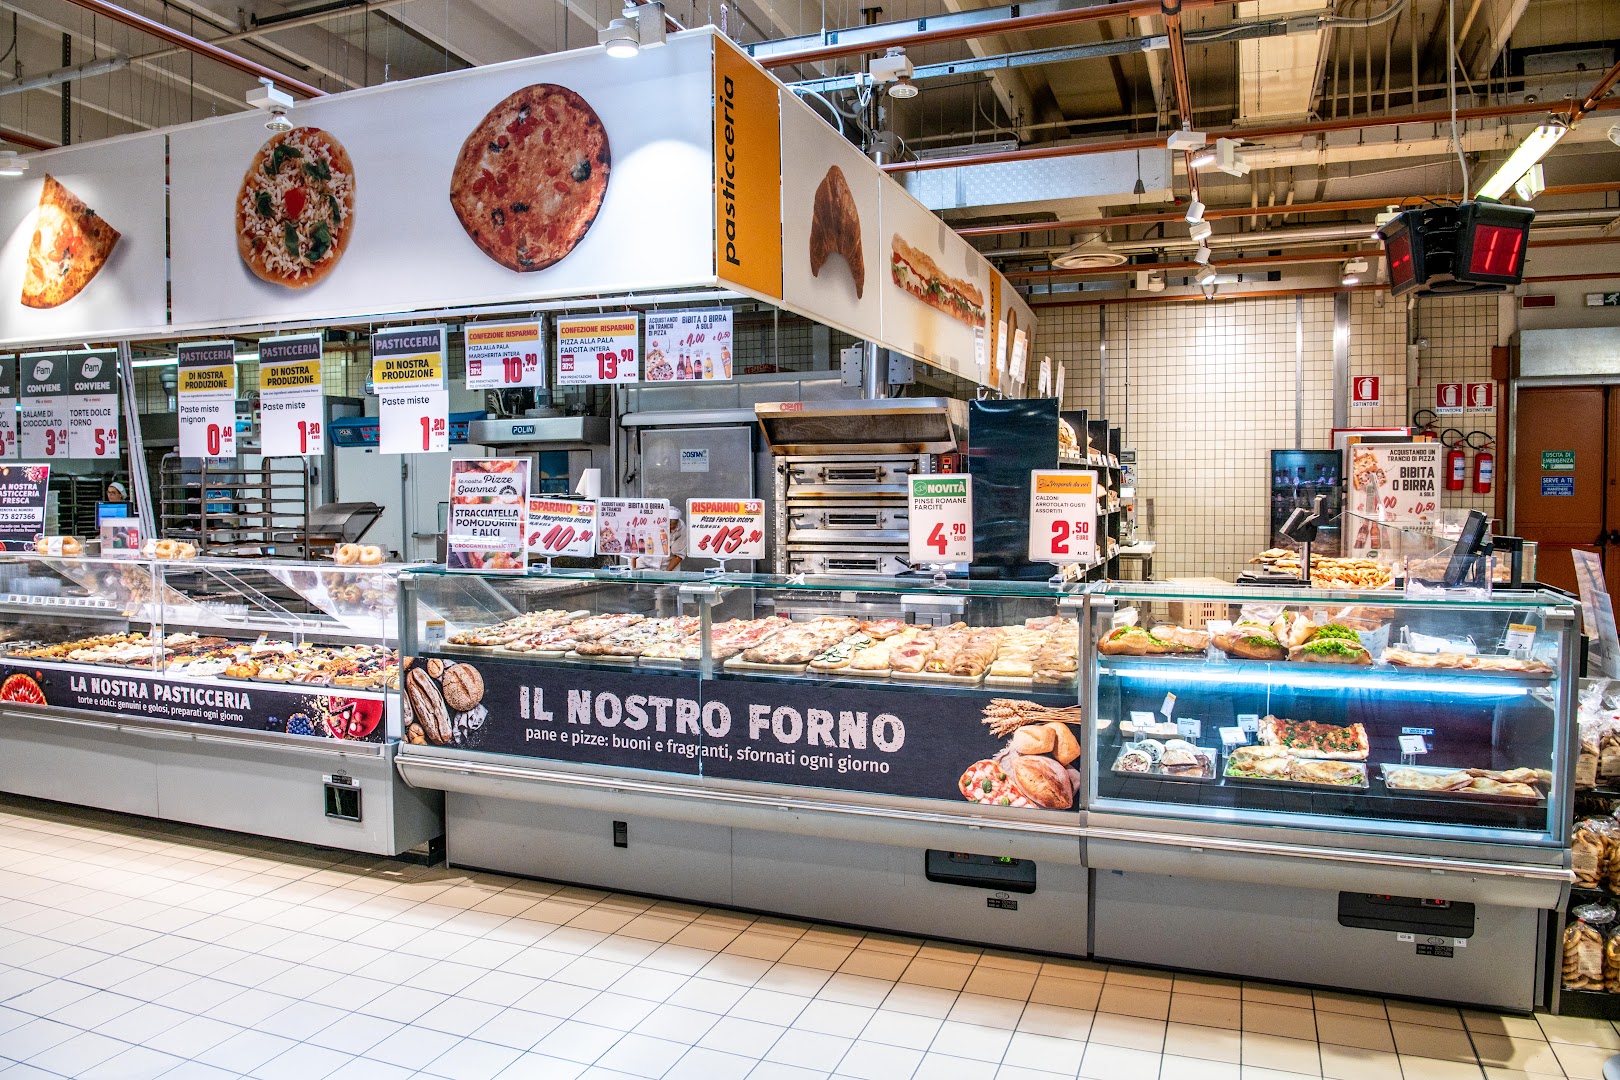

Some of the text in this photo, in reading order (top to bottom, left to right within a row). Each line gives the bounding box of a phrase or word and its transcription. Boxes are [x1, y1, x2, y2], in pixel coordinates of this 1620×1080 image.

[722, 76, 740, 266] pasticceria
[1485, 230, 1522, 272] 11
[682, 316, 701, 324] BIBITA
[709, 314, 727, 322] BIRRA
[561, 324, 635, 334] CONFEZIONE RISPARMIO
[469, 332, 504, 340] CONFEZIONE
[376, 336, 439, 350] PASTICCERIA
[180, 350, 232, 362] PASTICCERIA
[261, 344, 319, 358] PASTICCERIA
[37, 366, 51, 374] Pam
[85, 364, 99, 372] Pam
[386, 359, 429, 370] DI NOSTRA
[189, 371, 224, 380] DI NOSTRA
[271, 366, 309, 376] DI NOSTRA
[382, 369, 434, 380] PRODUZIONE
[185, 380, 227, 389] PRODUZIONE
[267, 375, 314, 386] PRODUZIONE
[27, 384, 61, 393] CONVIENE
[75, 382, 110, 391] CONVIENE
[286, 401, 305, 409] miste
[382, 396, 429, 406] Paste miste
[70, 409, 89, 417] TORTE
[201, 405, 219, 413] miste
[181, 416, 206, 424] mignon
[1400, 467, 1435, 478] BIBITA
[484, 475, 513, 483] Pizze
[458, 485, 497, 495] Gourmet
[928, 481, 966, 494] NOVITÀ
[1393, 480, 1435, 491] O BIRRA
[692, 502, 740, 513] RISPARMIO
[1415, 502, 1436, 515] 0,50
[1051, 520, 1089, 554] 2,50
[698, 535, 712, 551] €
[70, 676, 252, 711] LA NOSTRA PASTICCERIA
[78, 695, 244, 723] torte e dolci: genuini e golosi, preparati ogni giorno
[519, 685, 906, 753] IL NOSTRO FORNO
[526, 726, 890, 774] pane e pizze: buoni e fragranti, sfornati ogni giorno
